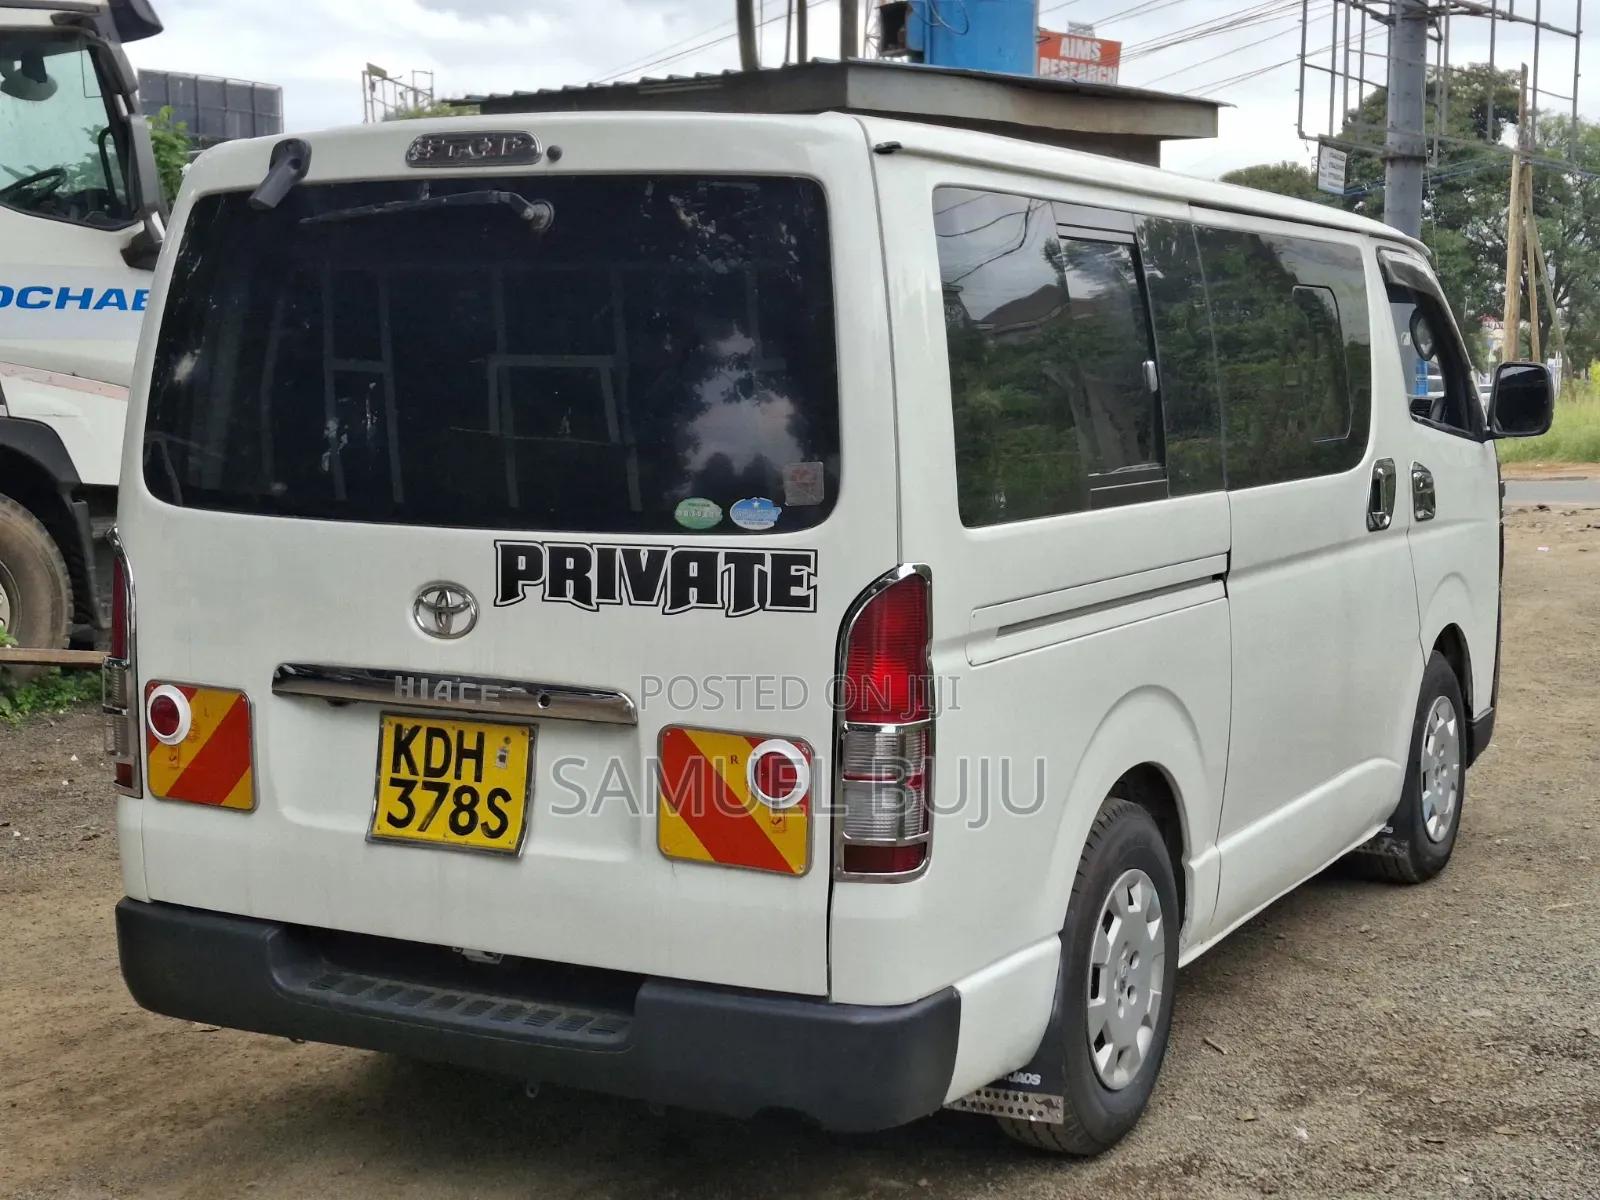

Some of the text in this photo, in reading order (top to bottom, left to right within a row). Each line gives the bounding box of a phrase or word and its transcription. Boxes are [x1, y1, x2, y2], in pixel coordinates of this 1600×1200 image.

[1060, 37, 1101, 61] AIMS
[494, 539, 818, 617] PRIVATE
[394, 675, 501, 705] HIACE
[391, 723, 485, 783] KDH
[730, 755, 740, 765] R
[386, 777, 512, 839] 378S
